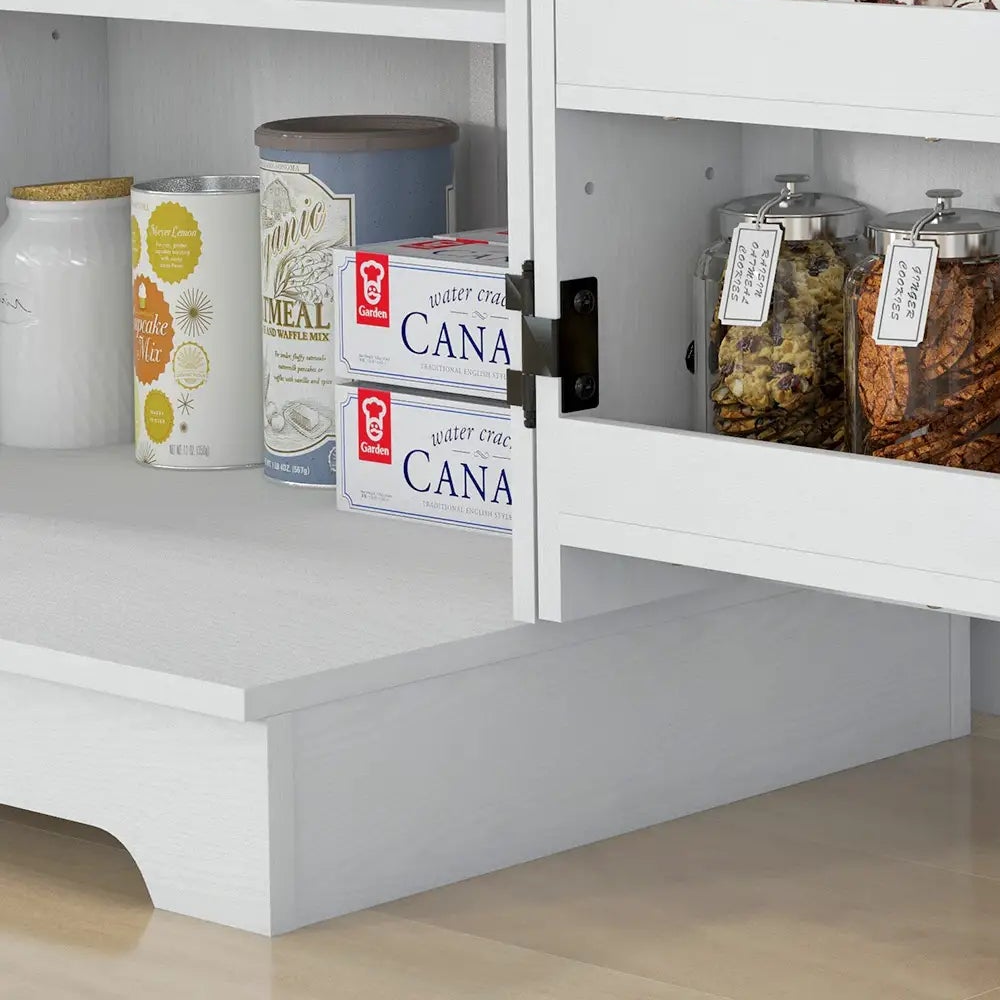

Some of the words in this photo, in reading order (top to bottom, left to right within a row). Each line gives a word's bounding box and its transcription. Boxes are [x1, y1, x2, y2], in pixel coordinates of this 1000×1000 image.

[429, 285, 473, 309] water
[358, 305, 388, 319] Garden
[277, 329, 307, 341] WAFFLE
[309, 333, 329, 342] MIX
[401, 311, 511, 366] CANA
[137, 336, 163, 363] Mix
[431, 423, 475, 447] water
[360, 441, 390, 456] Garden
[403, 450, 513, 506] CANA
